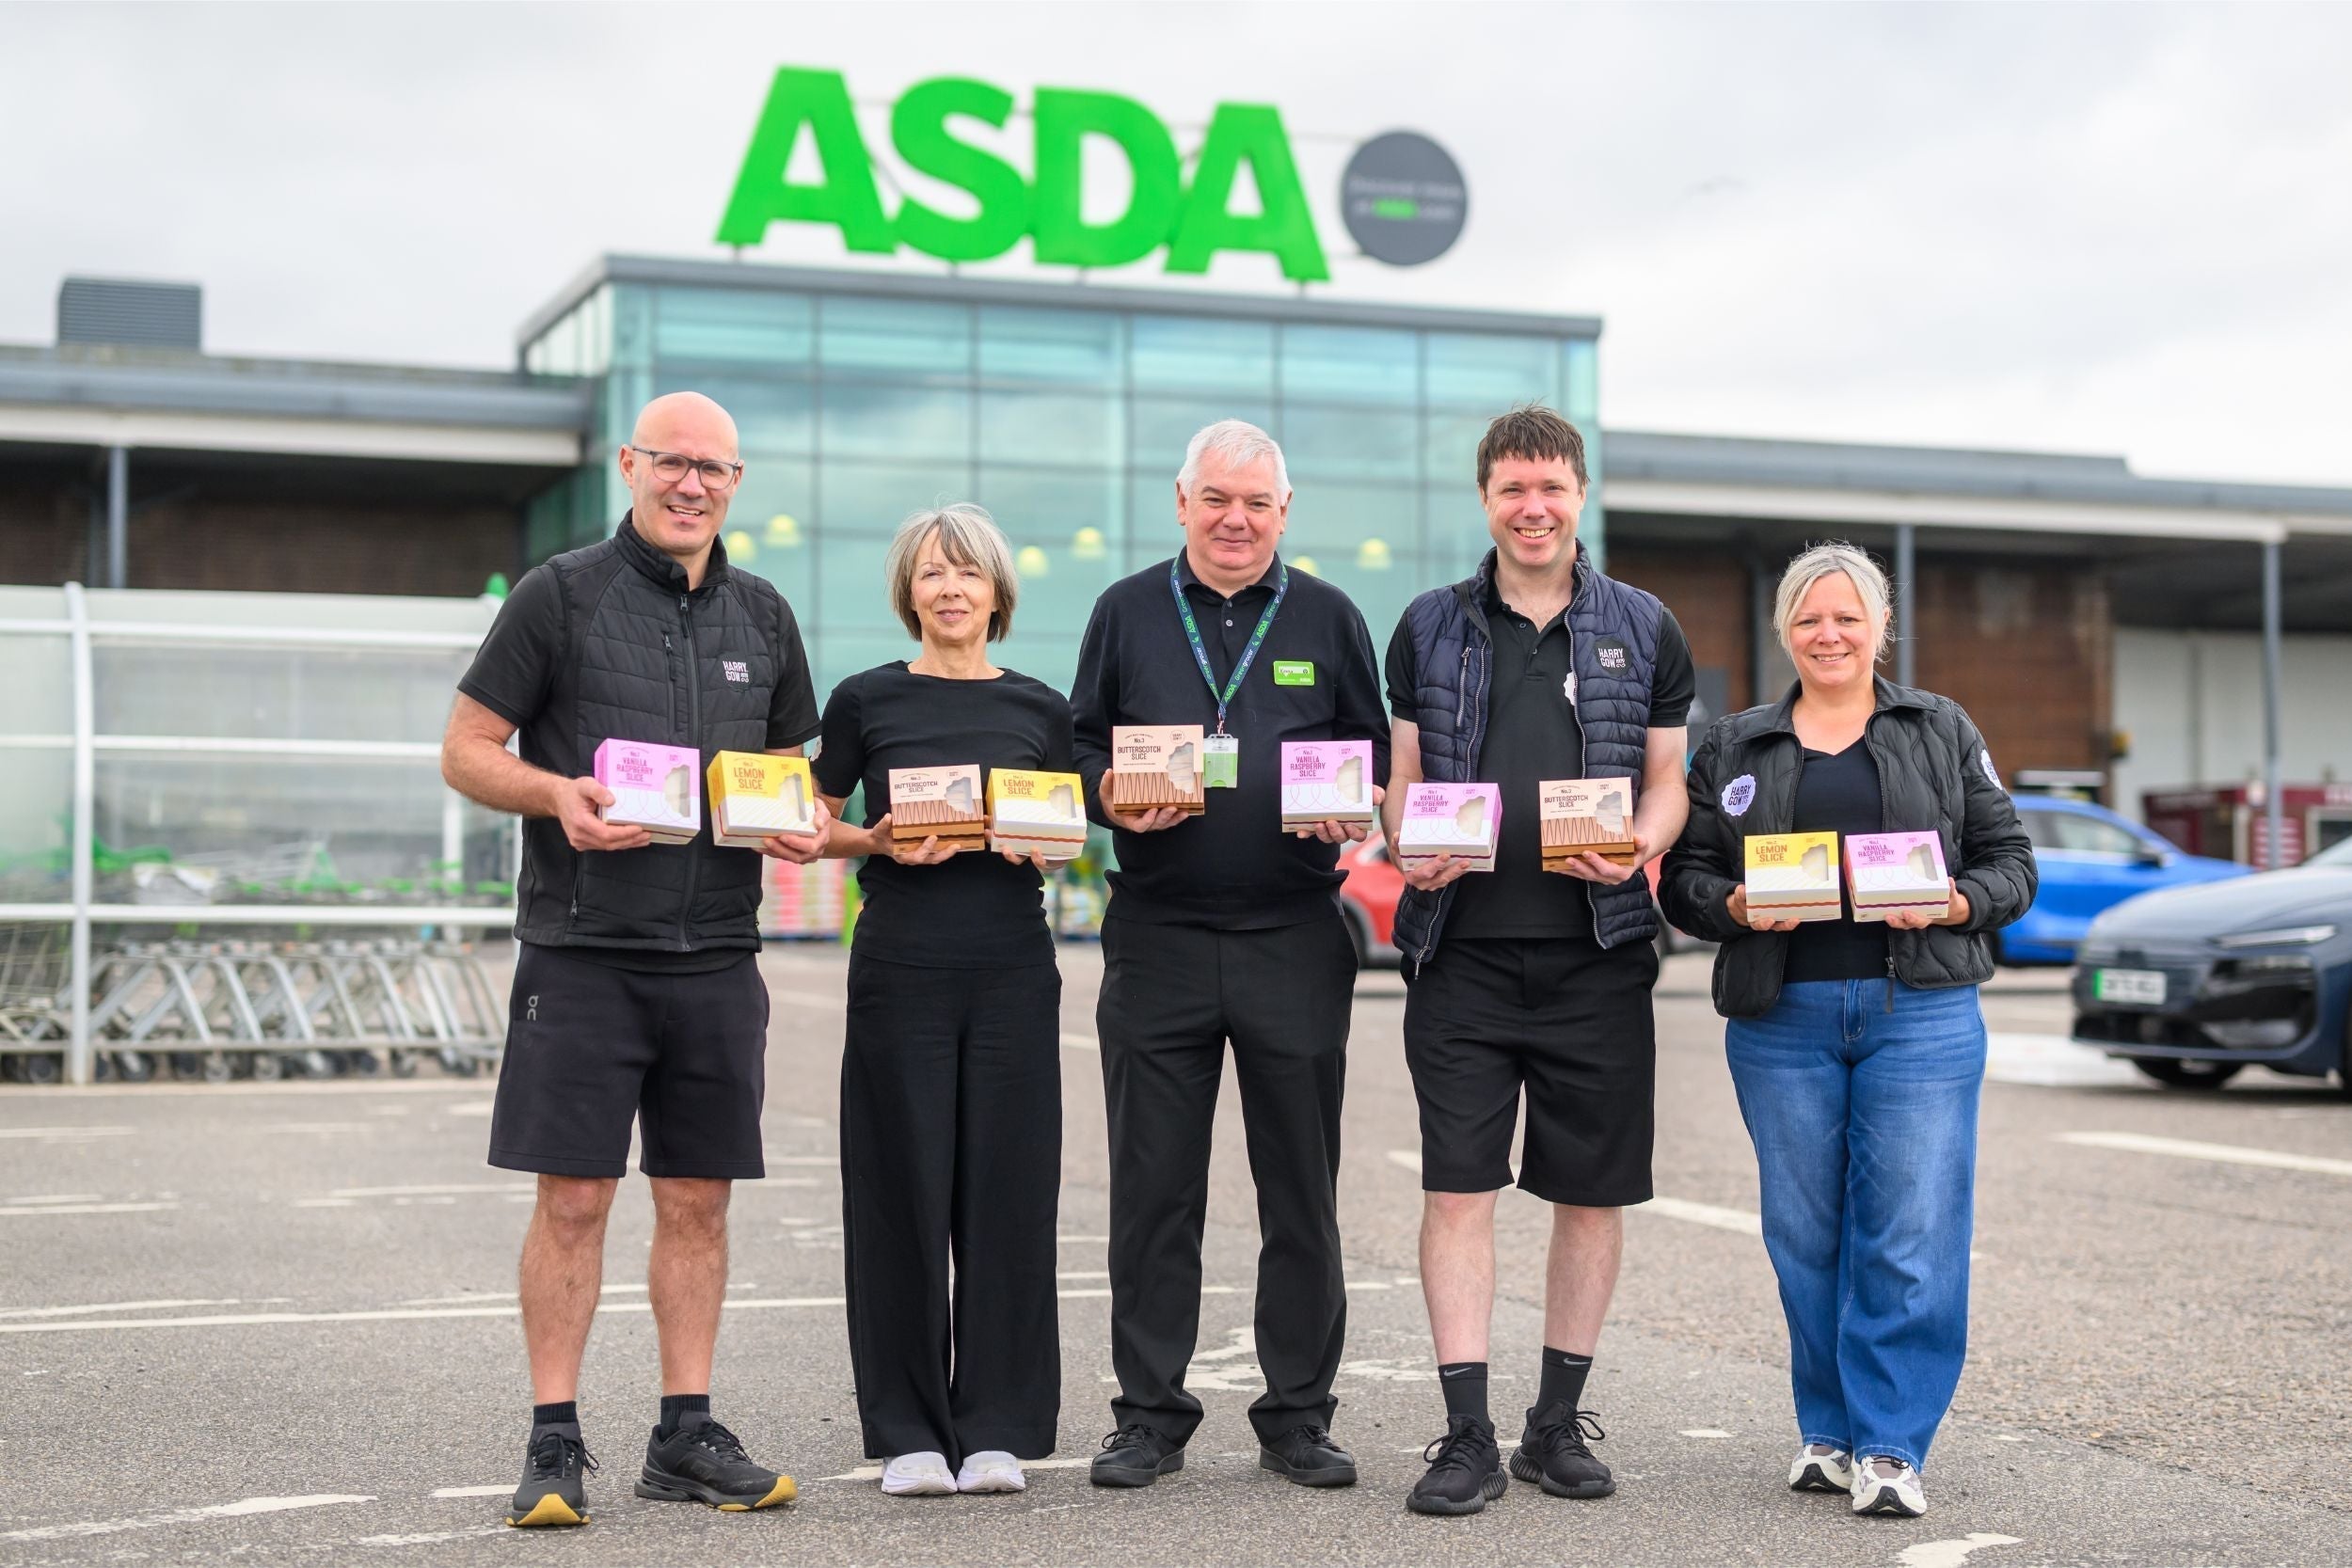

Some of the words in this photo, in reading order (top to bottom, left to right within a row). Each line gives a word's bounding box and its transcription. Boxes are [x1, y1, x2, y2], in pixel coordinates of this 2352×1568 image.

[715, 65, 1330, 282] ASDA
[1185, 615, 1197, 633] ASDA
[1257, 621, 1270, 638] ASDA
[1598, 647, 1623, 658] HARRY
[723, 660, 746, 673] HARRY
[1600, 657, 1615, 668] GOW
[725, 671, 740, 682] GOW
[623, 757, 647, 767] VANILLA
[616, 764, 653, 775] RASPBERRY
[734, 767, 766, 780] LEMON
[626, 772, 644, 782] SLICE
[739, 779, 763, 790] SLICE
[894, 781, 938, 790] BUTTERSCOTCH
[1003, 778, 1035, 788] LEMON
[1008, 786, 1032, 796] SLICE
[1731, 784, 1752, 797] HARRY
[1544, 795, 1589, 803] BUTTERSCOTCH
[1756, 844, 1788, 855] LEMON
[1759, 853, 1785, 863] SLICE
